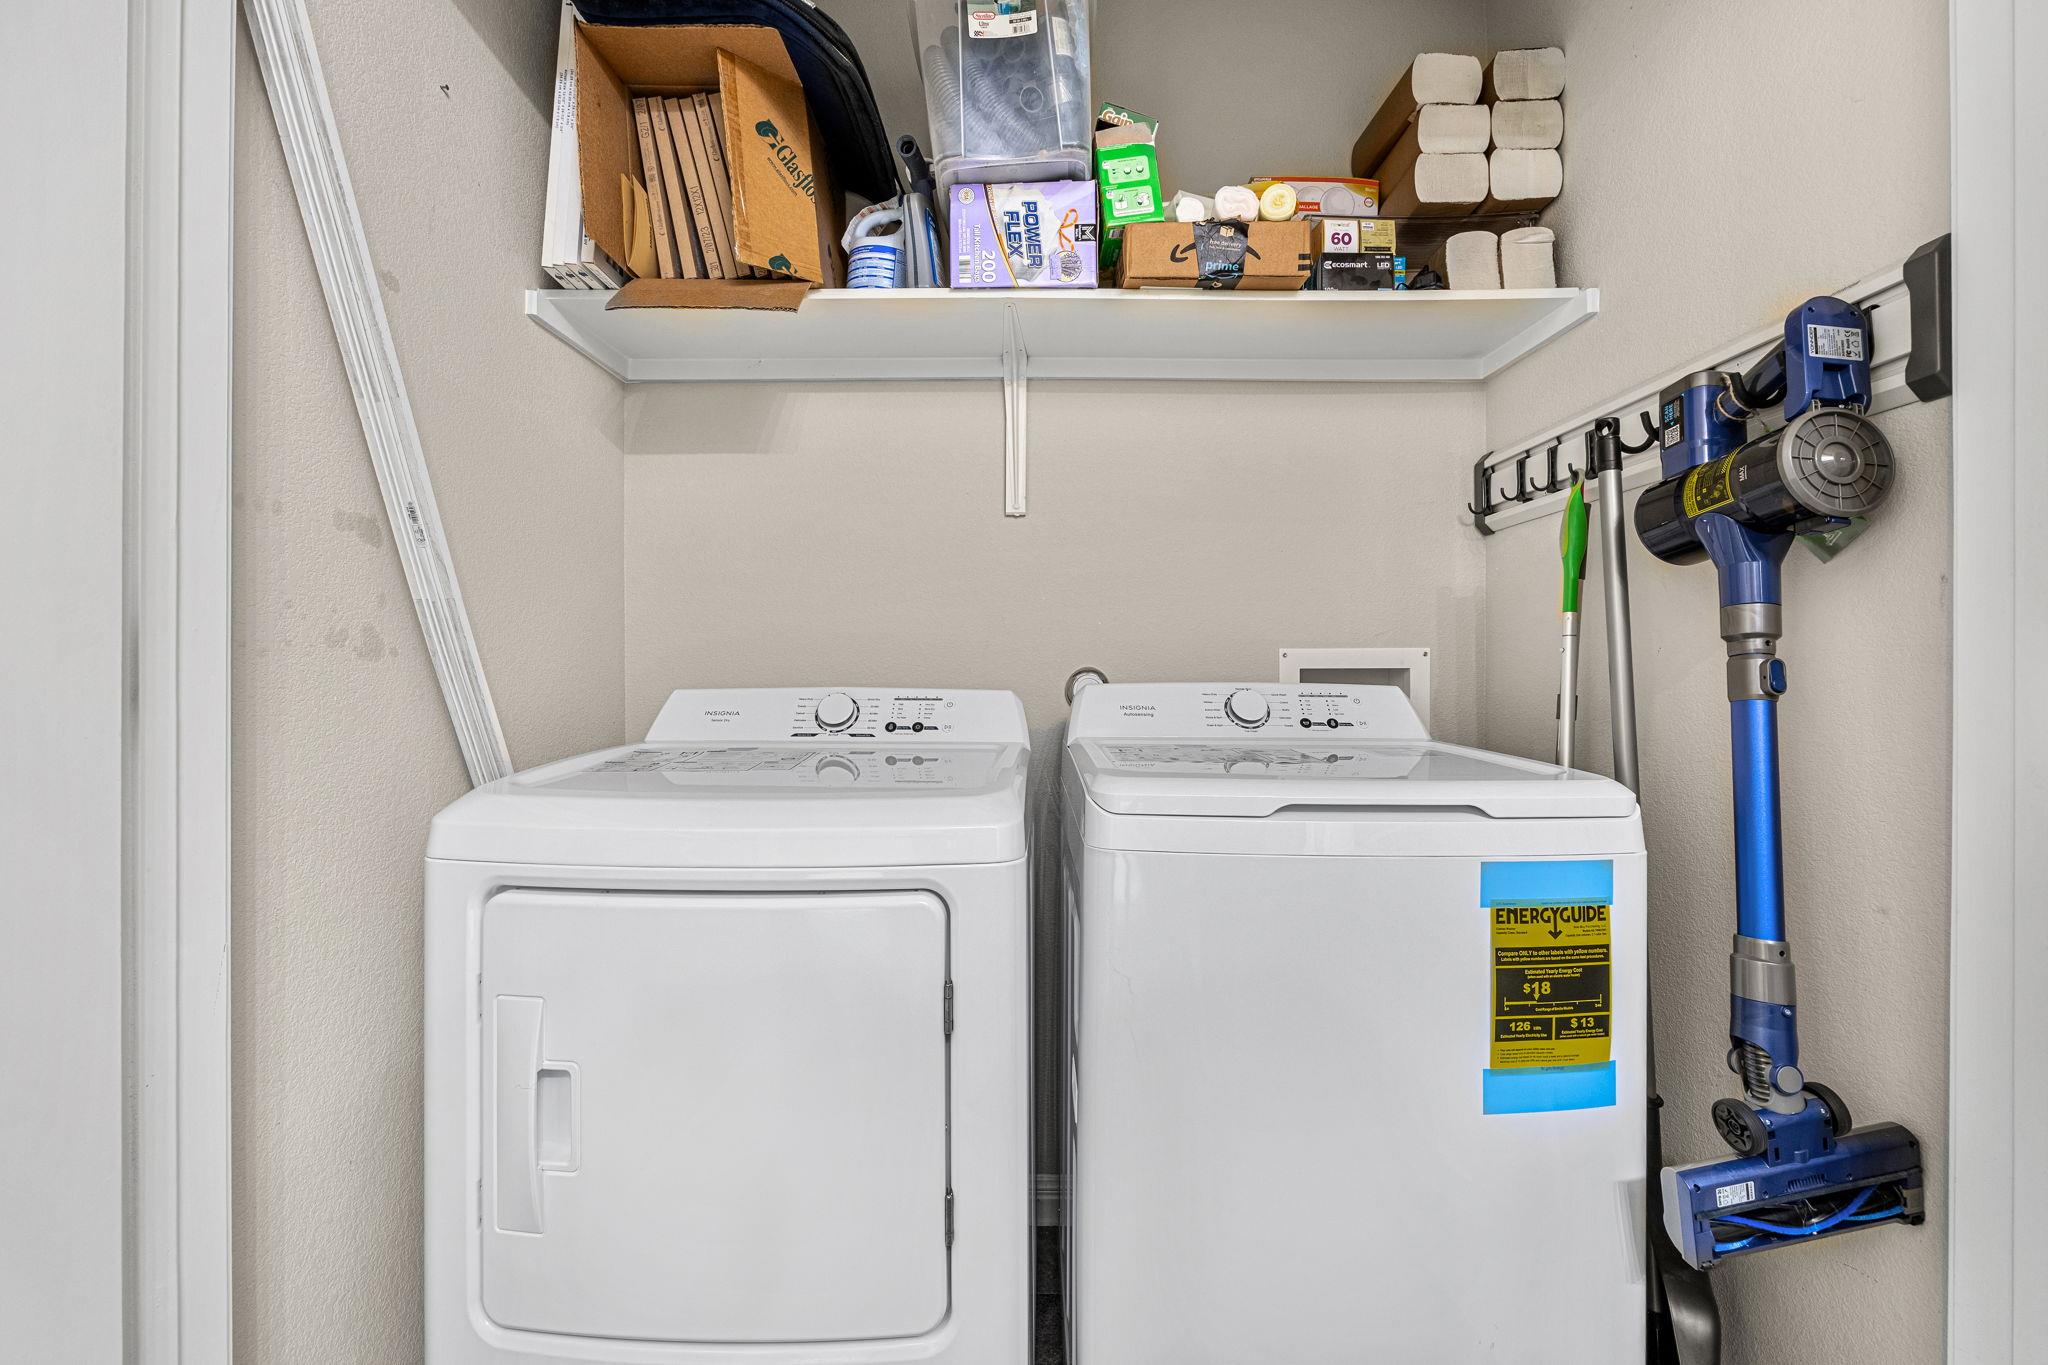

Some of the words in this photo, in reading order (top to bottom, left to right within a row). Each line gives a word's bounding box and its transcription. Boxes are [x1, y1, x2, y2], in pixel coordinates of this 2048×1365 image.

[1003, 210, 1024, 259] FLEX
[1021, 201, 1043, 269] POWER
[1331, 232, 1352, 246] 60
[981, 250, 996, 283] 200
[1205, 260, 1239, 271] prime
[1495, 905, 1607, 925] ENERGYGUIDE
[1509, 1021, 1531, 1032] 126
